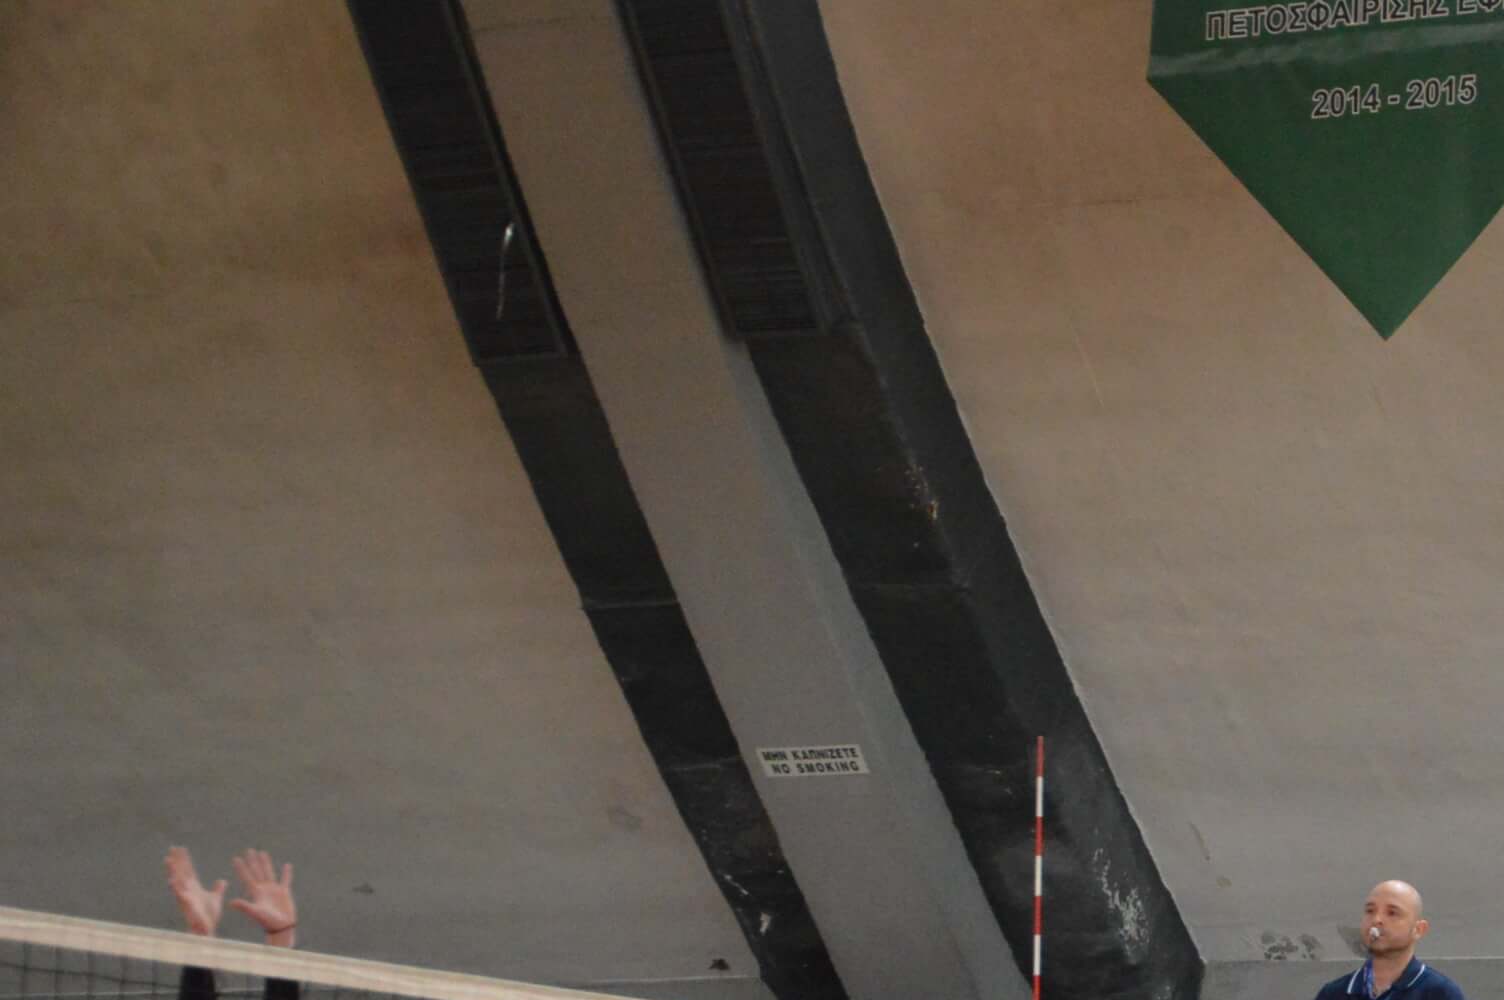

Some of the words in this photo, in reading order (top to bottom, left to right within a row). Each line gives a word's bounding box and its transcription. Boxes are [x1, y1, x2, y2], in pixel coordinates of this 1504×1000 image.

[1311, 84, 1380, 118] 2014
[1406, 74, 1477, 111] 2015
[771, 763, 790, 774] NO
[796, 760, 860, 773] SMOKING
